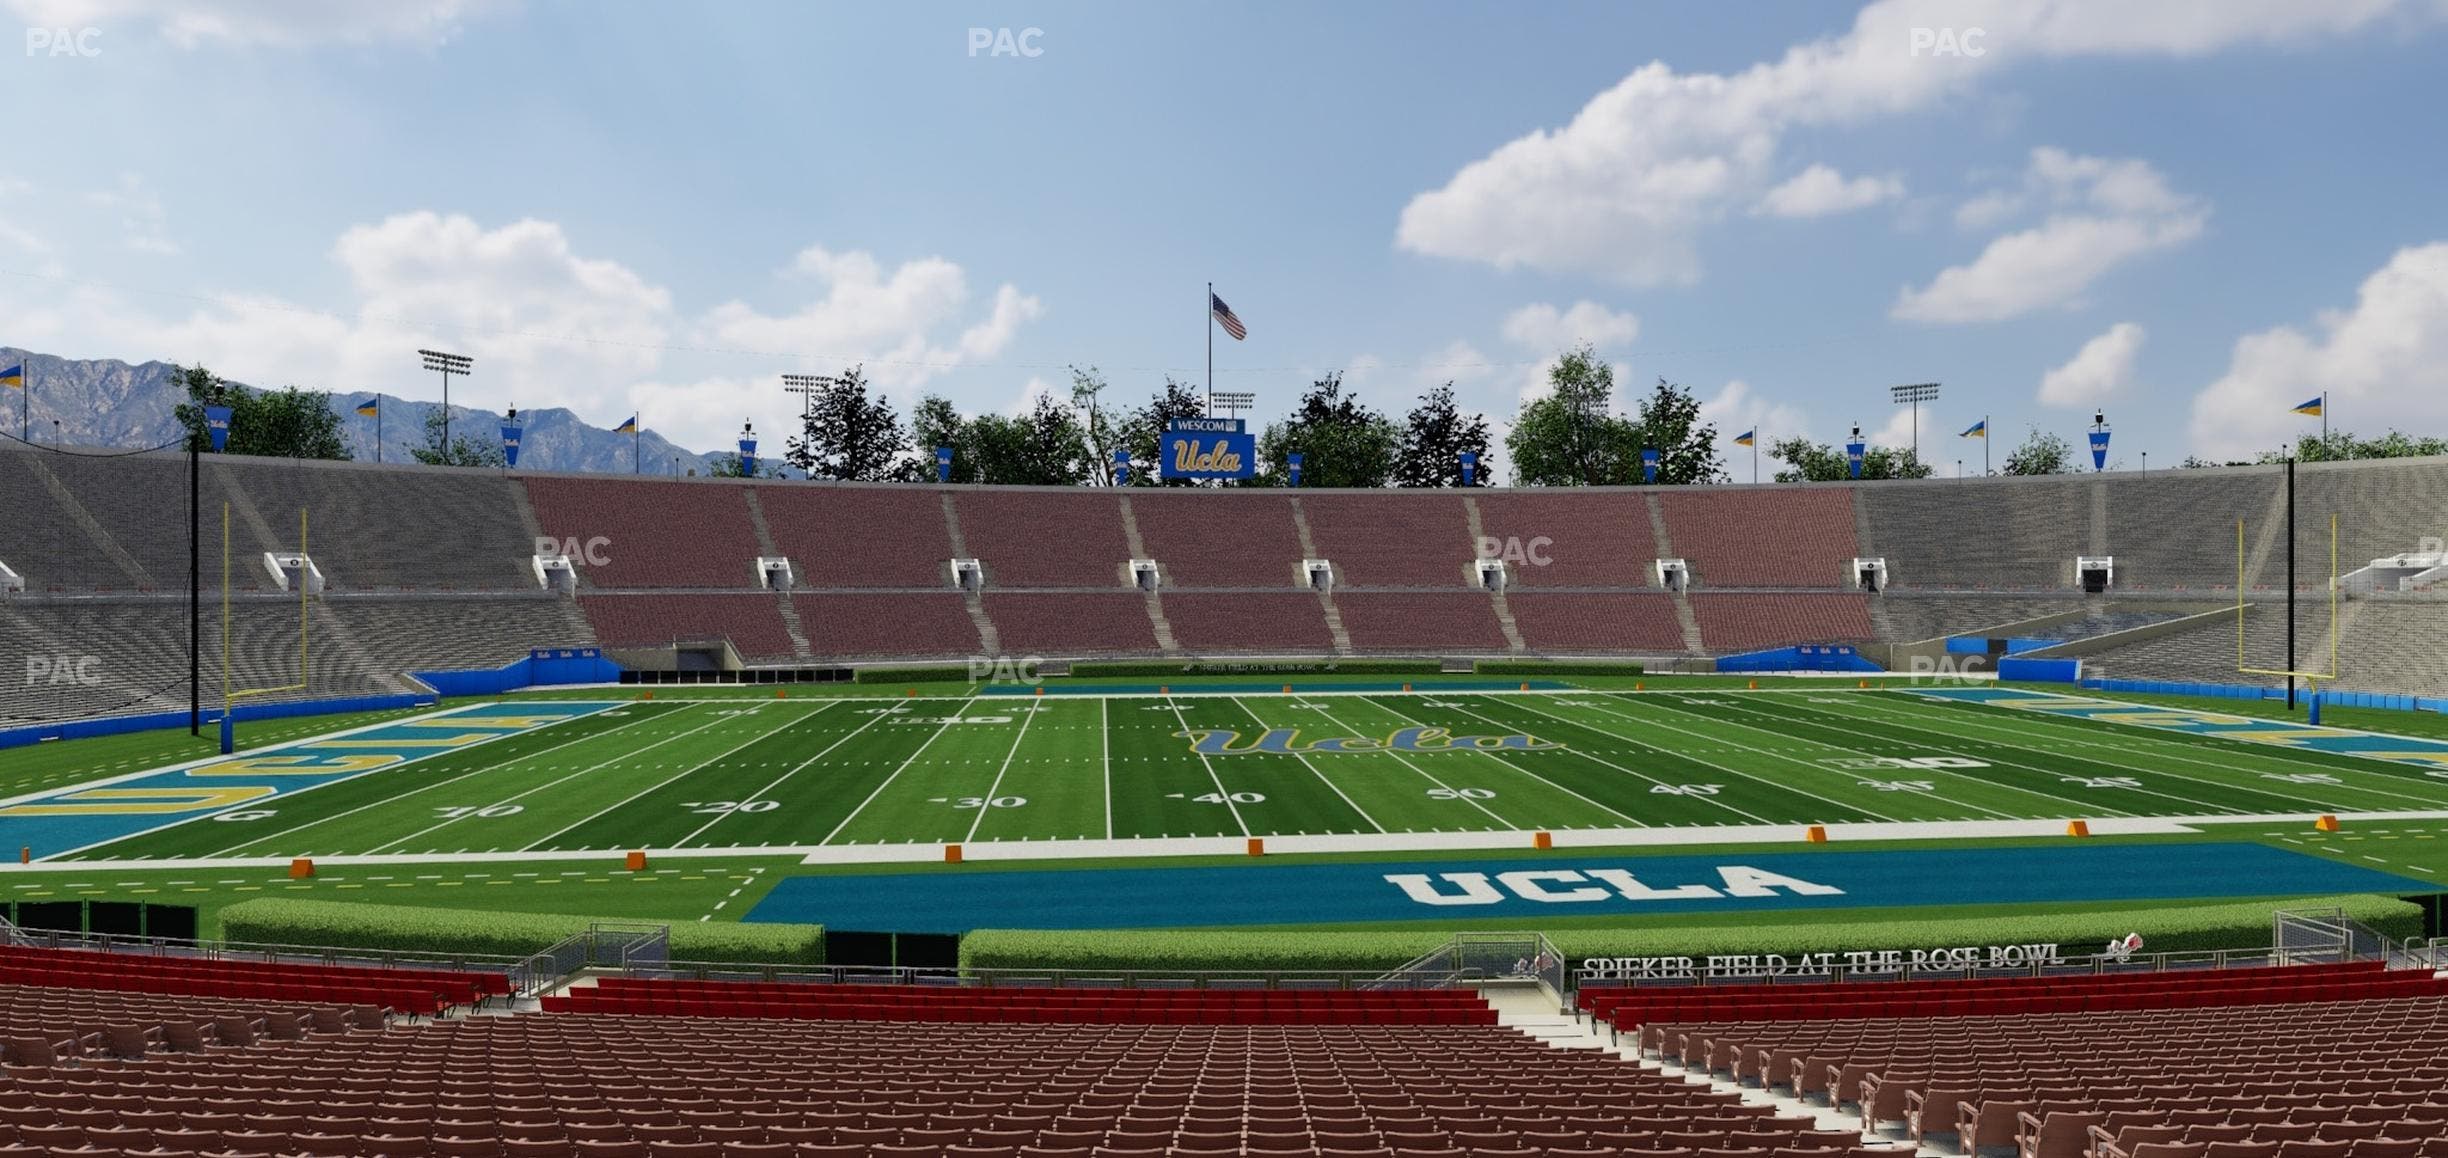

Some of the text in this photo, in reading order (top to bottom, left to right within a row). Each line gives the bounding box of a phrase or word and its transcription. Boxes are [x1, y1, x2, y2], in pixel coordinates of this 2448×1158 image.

[1178, 421, 1224, 431] WESCOM
[1173, 440, 1242, 471] Ucla
[1172, 727, 1567, 754] Ucla
[1192, 793, 1266, 804] 40
[1425, 788, 1497, 799] 50
[691, 801, 781, 813] 20
[952, 796, 1027, 808] 30
[1383, 865, 1847, 905] UCLA
[1583, 944, 2065, 979] SPIEKER FIELD AT THE ROSE BOWL
